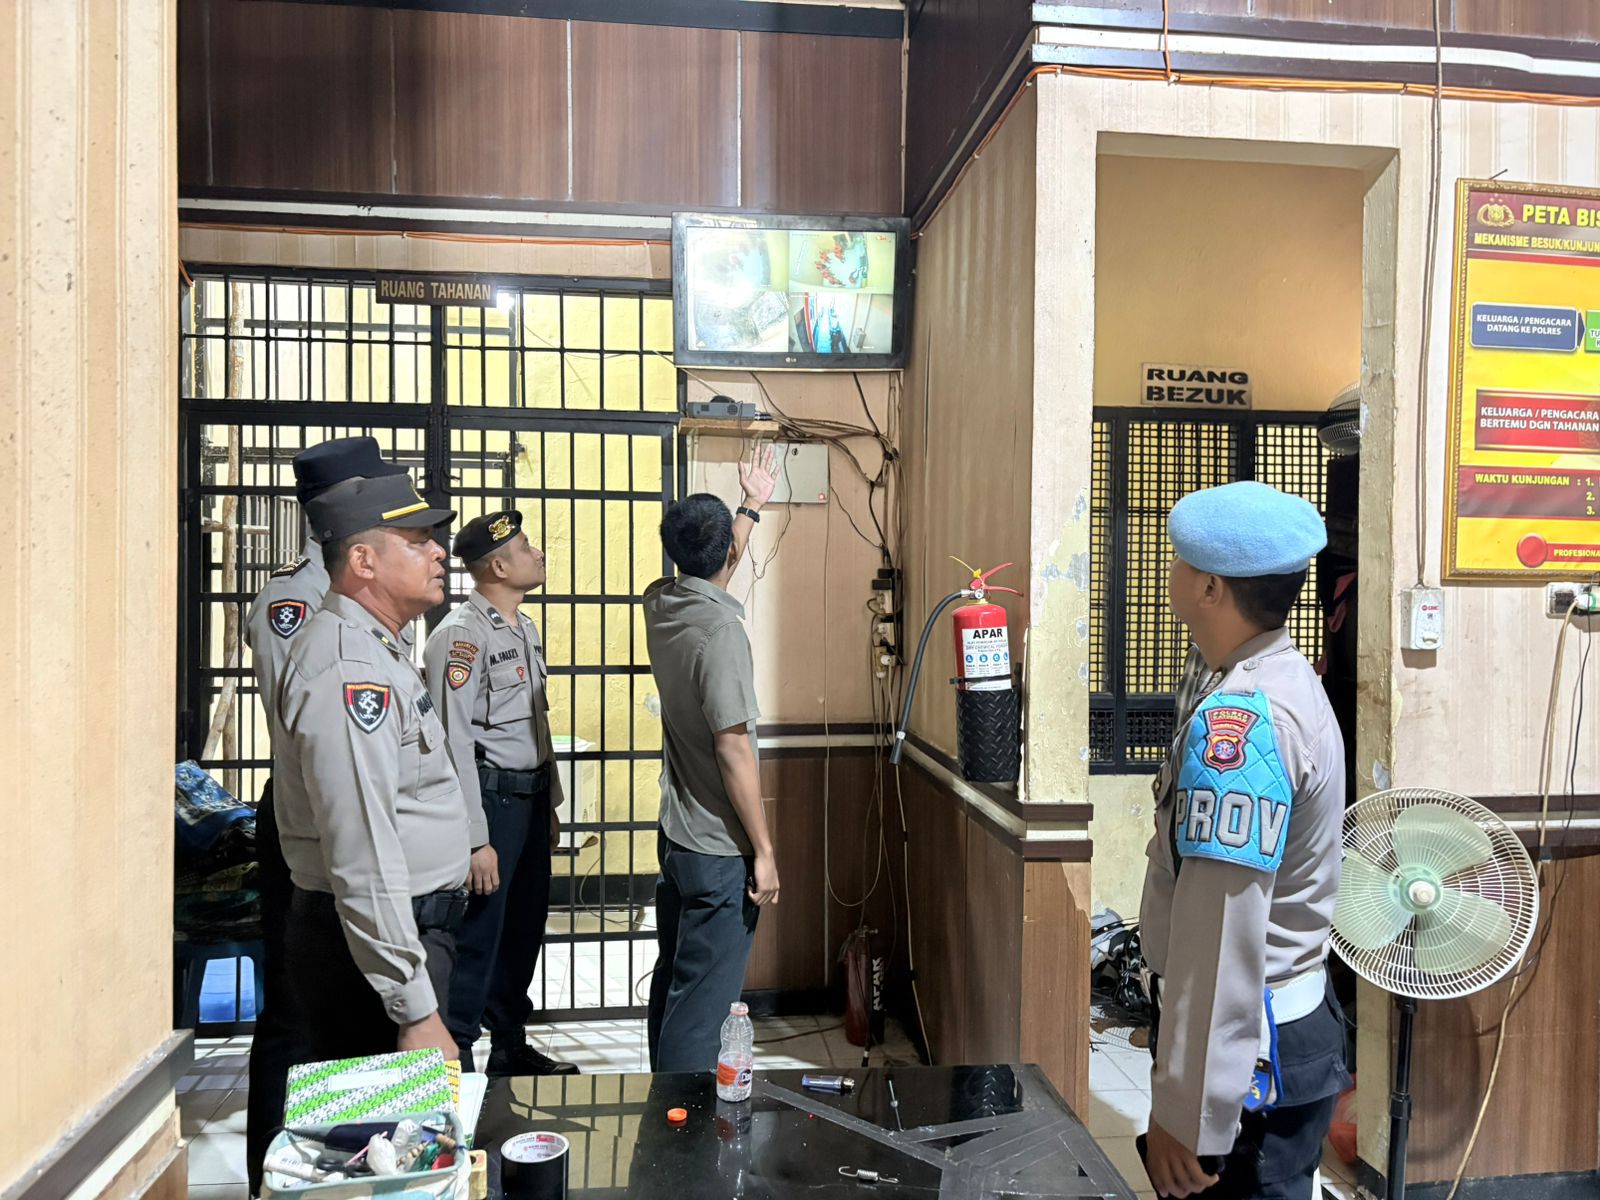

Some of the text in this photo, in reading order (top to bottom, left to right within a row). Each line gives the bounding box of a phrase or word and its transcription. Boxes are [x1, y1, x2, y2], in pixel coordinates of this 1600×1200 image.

[1522, 204, 1571, 225] PETA
[1474, 232, 1530, 248] MEKANISME
[381, 279, 491, 300] RUANG TAHANAN
[1476, 314, 1519, 324] KELUARGA
[1524, 317, 1572, 327] PENGACARA
[1487, 324, 1562, 336] DATANG KE POLRES
[1147, 368, 1249, 385] RUANG
[1146, 385, 1247, 406] BEZUK
[1481, 406, 1533, 418] KELUARGA
[1541, 409, 1600, 421] PENGACARA
[1480, 418, 1600, 432] BERTEMU DGN TAHANAN
[1475, 473, 1509, 484] WAKTU
[1511, 475, 1570, 486] KUNJUNGAN
[1585, 476, 1595, 487] 1.
[1586, 491, 1595, 502] 2.
[1586, 505, 1595, 516] 3.
[973, 628, 1003, 639] APAR
